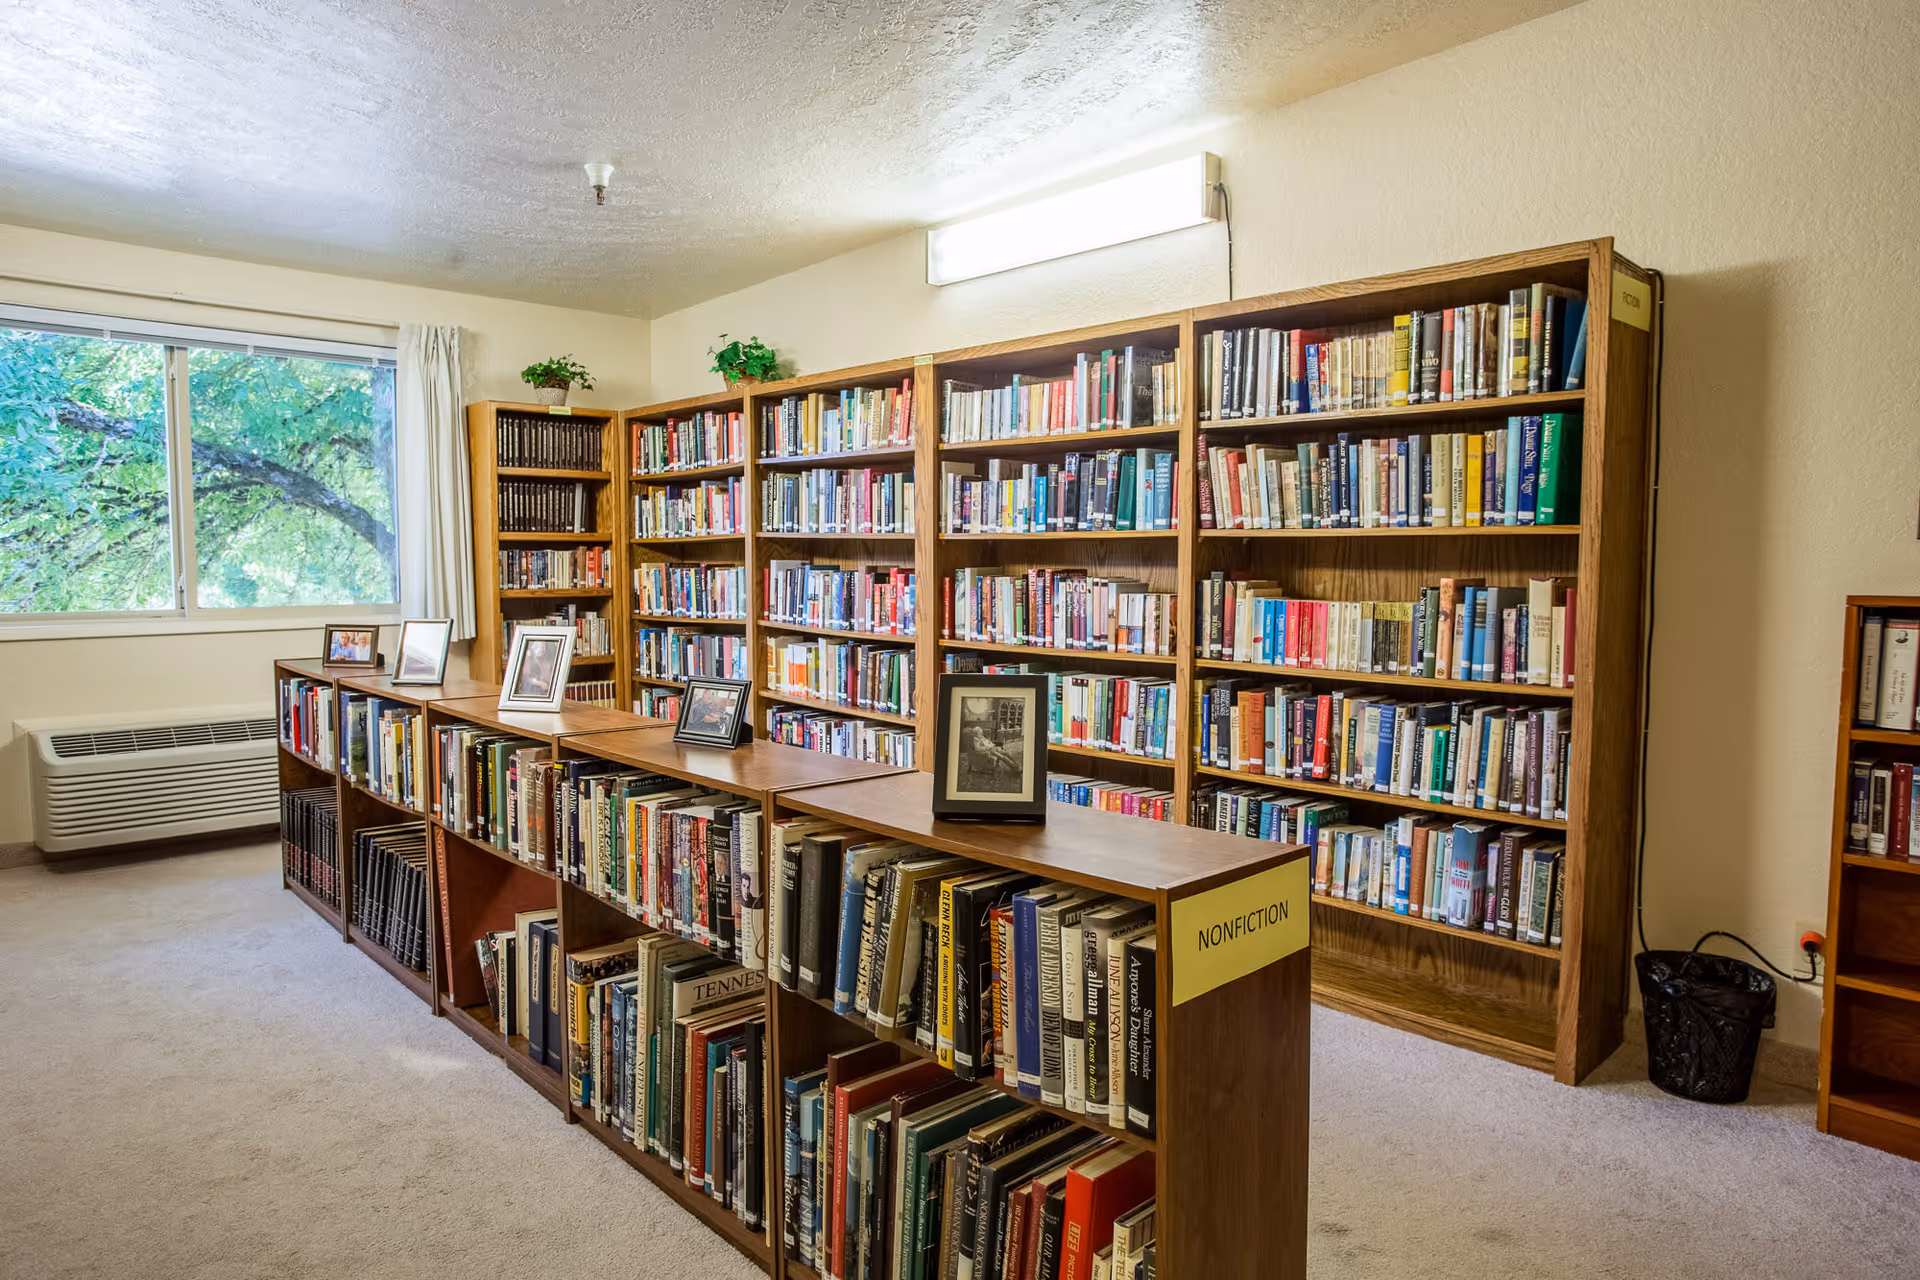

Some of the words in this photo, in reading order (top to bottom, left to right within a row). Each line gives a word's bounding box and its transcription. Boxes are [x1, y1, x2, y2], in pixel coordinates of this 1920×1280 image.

[1395, 720, 1404, 752] Investigation
[1219, 797, 1229, 819] NAKED
[1248, 800, 1258, 824] SUSAN
[605, 818, 610, 834] ON
[436, 829, 445, 883] Norman
[1503, 837, 1513, 866] HERMAN
[1502, 867, 1512, 886] WOUK
[942, 890, 950, 920] GLENN
[1500, 897, 1510, 920] GLORY
[440, 890, 451, 951] Rockwell
[991, 920, 999, 939] DAVE
[1040, 915, 1059, 948] TERRY
[1199, 900, 1289, 952] NONFICTION
[876, 922, 890, 953] Why
[941, 923, 949, 948] BECK
[998, 917, 1008, 971] TYRONE
[991, 942, 999, 969] BARRY
[1064, 951, 1076, 985] Good
[1041, 951, 1060, 1008] ANDERSON
[1108, 954, 1121, 986] JUNE
[694, 970, 765, 1001] TENNES
[1128, 956, 1141, 1013] Anyone's
[569, 983, 577, 1038] Chronicle
[992, 982, 1000, 1032] CYBERSPACE
[1000, 974, 1009, 1028] POWER
[1065, 990, 1076, 1014] Son
[1109, 987, 1121, 1042] ALLYSON
[1042, 1010, 1060, 1031] DEN
[1088, 1020, 1096, 1033] My
[1142, 1008, 1152, 1034] Shana
[1043, 1033, 1060, 1048] OF
[1088, 1037, 1097, 1062] Cross
[1129, 1016, 1141, 1075] Daughter
[1043, 1048, 1061, 1080] LIONS
[1089, 1065, 1097, 1074] to
[1111, 1048, 1121, 1065] June
[1141, 1036, 1151, 1079] Alexander
[696, 1065, 705, 1088] LAST
[1089, 1076, 1098, 1099] Bear
[1111, 1066, 1121, 1094] Allyson
[828, 1136, 833, 1145] WE
[827, 1166, 833, 1175] IN
[906, 1155, 914, 1183] Porter
[904, 1188, 912, 1208] Birds
[952, 1184, 963, 1227] NORMAN
[903, 1224, 911, 1244] North
[977, 1198, 988, 1243] NORMAN
[1012, 1216, 1020, 1241] Favorite
[1045, 1233, 1053, 1257] OUR
[1068, 1223, 1080, 1251] LIFE
[1117, 1235, 1126, 1256] THE
[901, 1245, 910, 1280] America
[1009, 1243, 1018, 1271] Paintings
[1009, 1272, 1016, 1280] by
